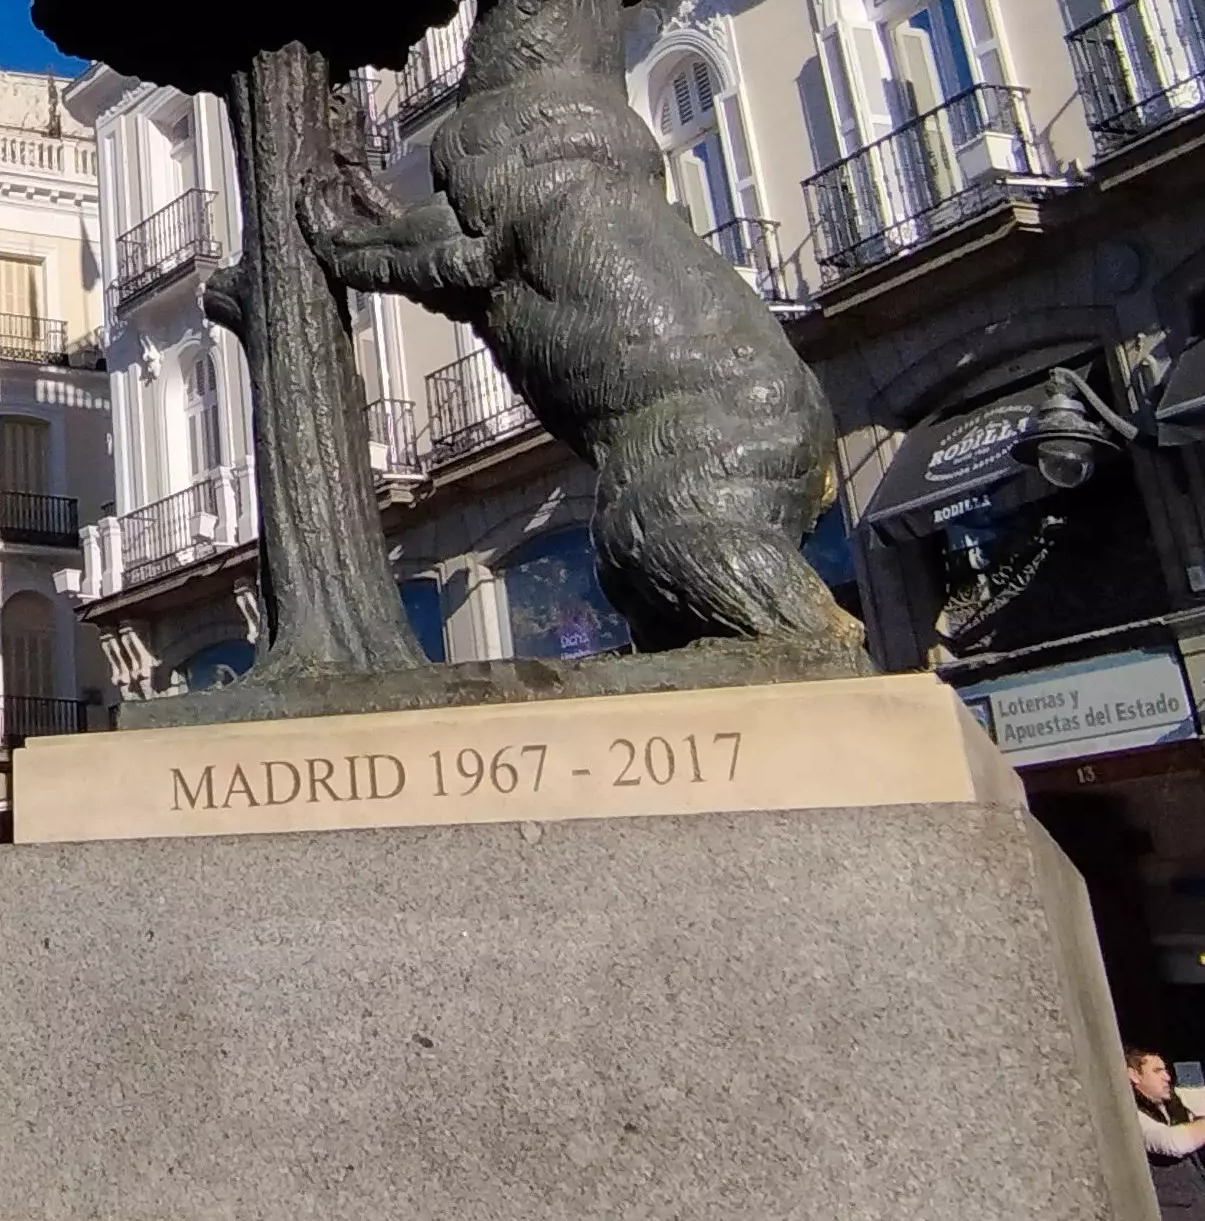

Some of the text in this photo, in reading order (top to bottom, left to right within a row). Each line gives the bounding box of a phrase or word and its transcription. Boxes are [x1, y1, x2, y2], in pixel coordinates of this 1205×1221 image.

[934, 494, 992, 523] RODILLA
[1069, 690, 1079, 708] y
[1004, 715, 1080, 745] Apuestas
[1085, 703, 1112, 727] del
[1116, 692, 1180, 722] Estado
[170, 754, 407, 811] MADRID
[429, 744, 549, 798] 1967
[608, 732, 742, 787] 2017
[1077, 765, 1096, 783] 13
